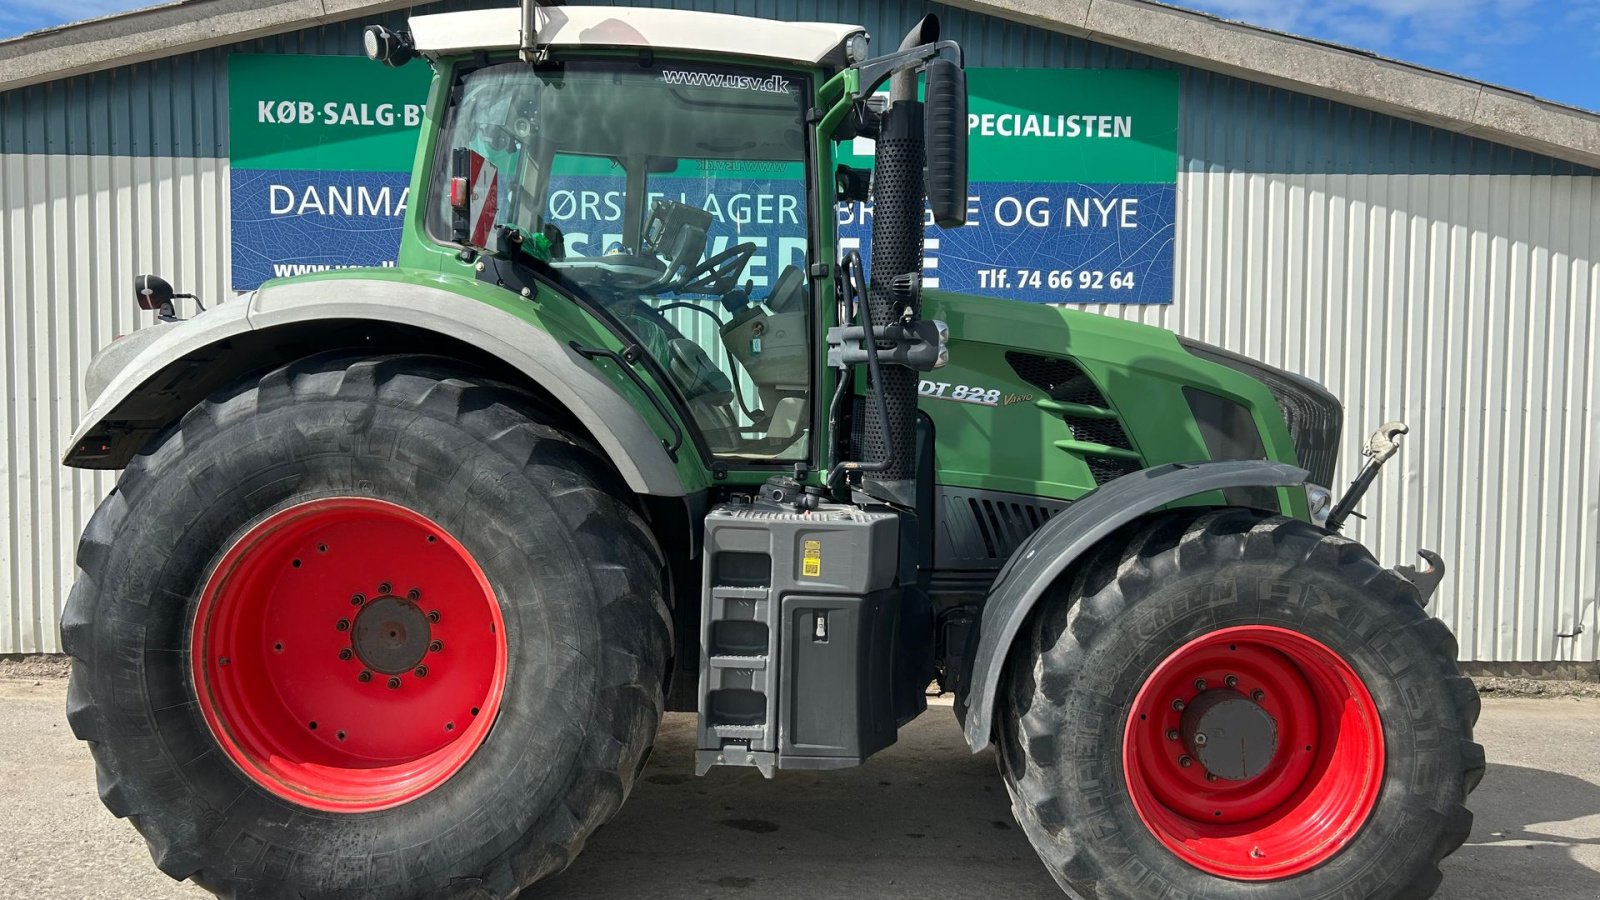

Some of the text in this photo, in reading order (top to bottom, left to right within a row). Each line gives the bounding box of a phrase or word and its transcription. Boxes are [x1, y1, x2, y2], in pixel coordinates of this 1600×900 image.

[662, 70, 789, 94] www.usv.dk
[258, 99, 427, 127] KØB·SALG·B
[994, 196, 1050, 228] OG
[1065, 197, 1139, 228] NYE
[977, 269, 1135, 290] Tlf. 74 66 92 64
[951, 385, 1001, 404] 828
